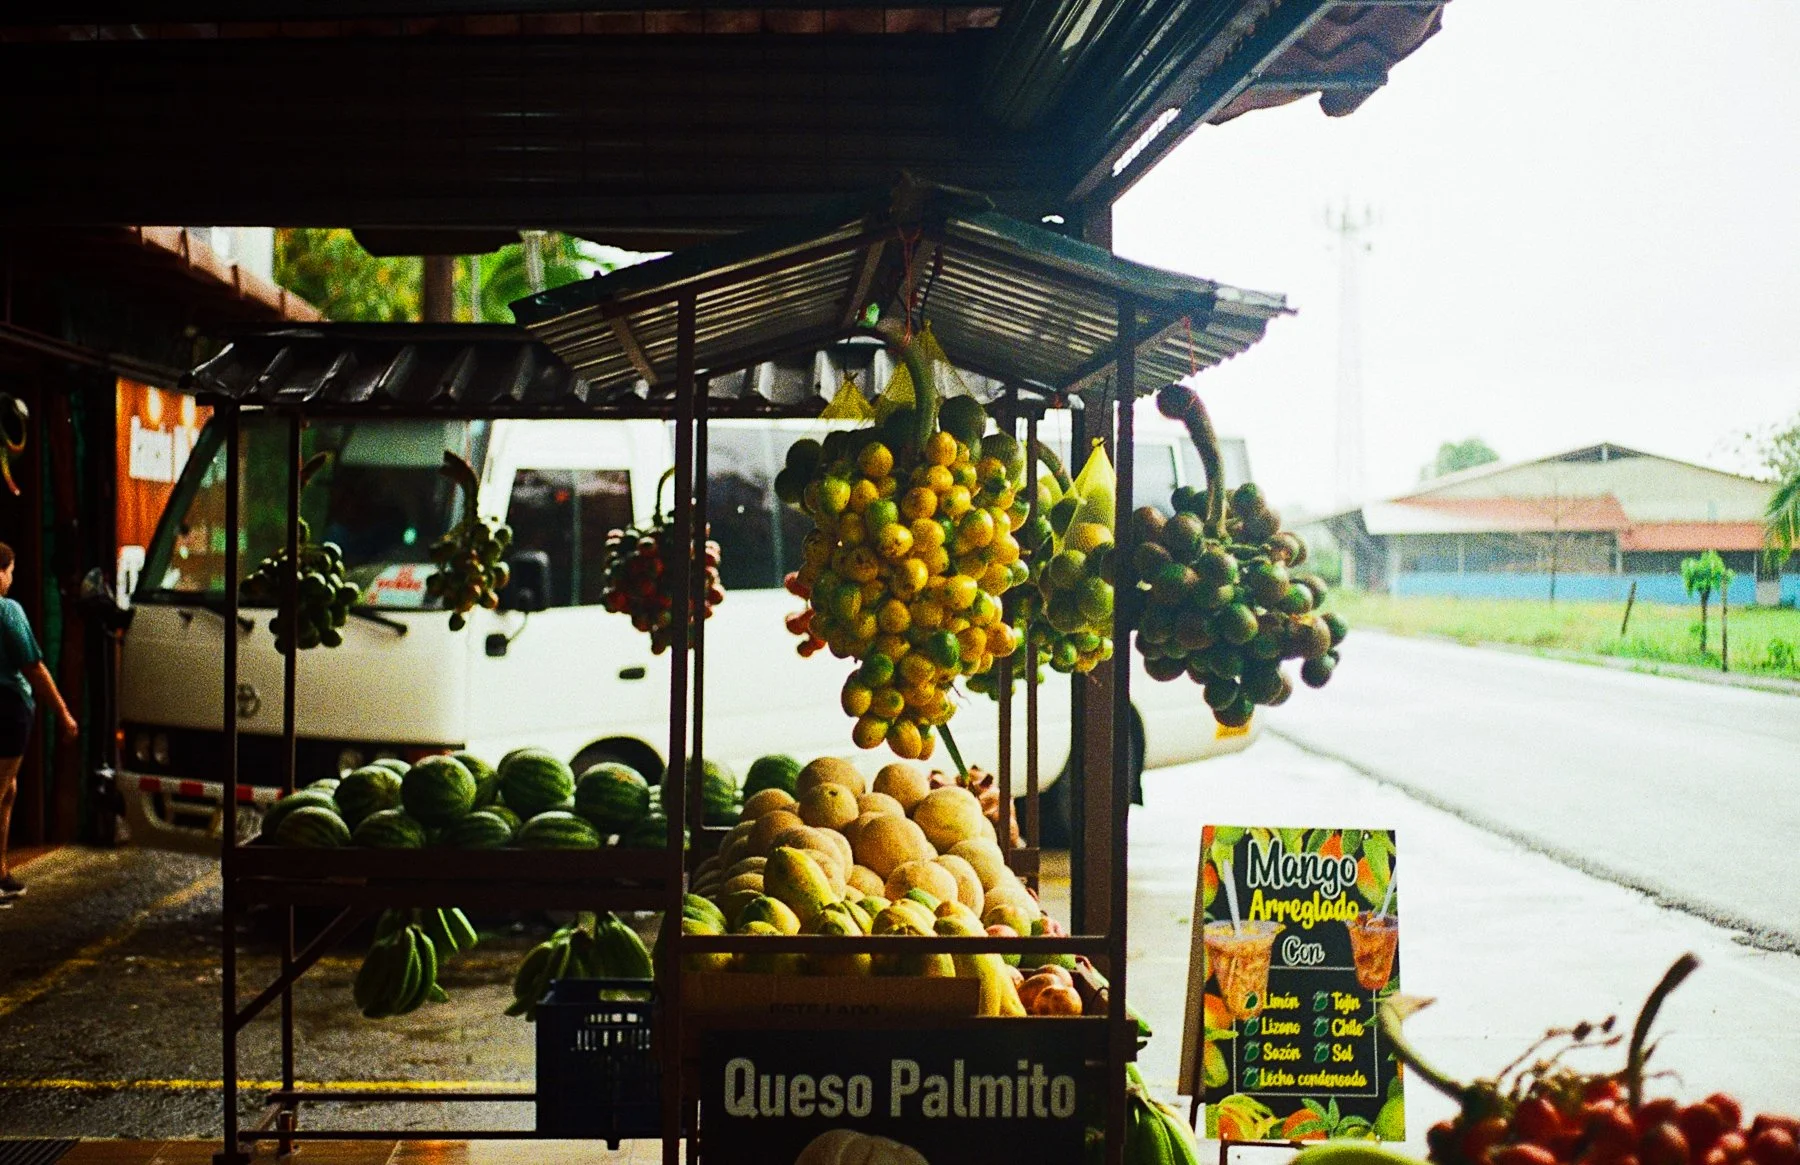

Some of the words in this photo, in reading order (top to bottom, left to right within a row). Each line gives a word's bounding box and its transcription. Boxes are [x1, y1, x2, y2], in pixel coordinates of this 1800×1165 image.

[1247, 839, 1358, 900] Mango
[1250, 889, 1359, 929] Arreglado
[1283, 935, 1326, 966] Con
[1262, 992, 1300, 1010] Limón
[1261, 1017, 1301, 1034] Lizano
[1331, 1017, 1365, 1037] Chile
[1263, 1042, 1302, 1061] Sazón
[1332, 1043, 1355, 1062] Sal
[1259, 1067, 1296, 1086] Leche
[1298, 1068, 1368, 1087] condensada
[724, 1057, 873, 1119] Queso
[890, 1058, 1076, 1118] Palmito
